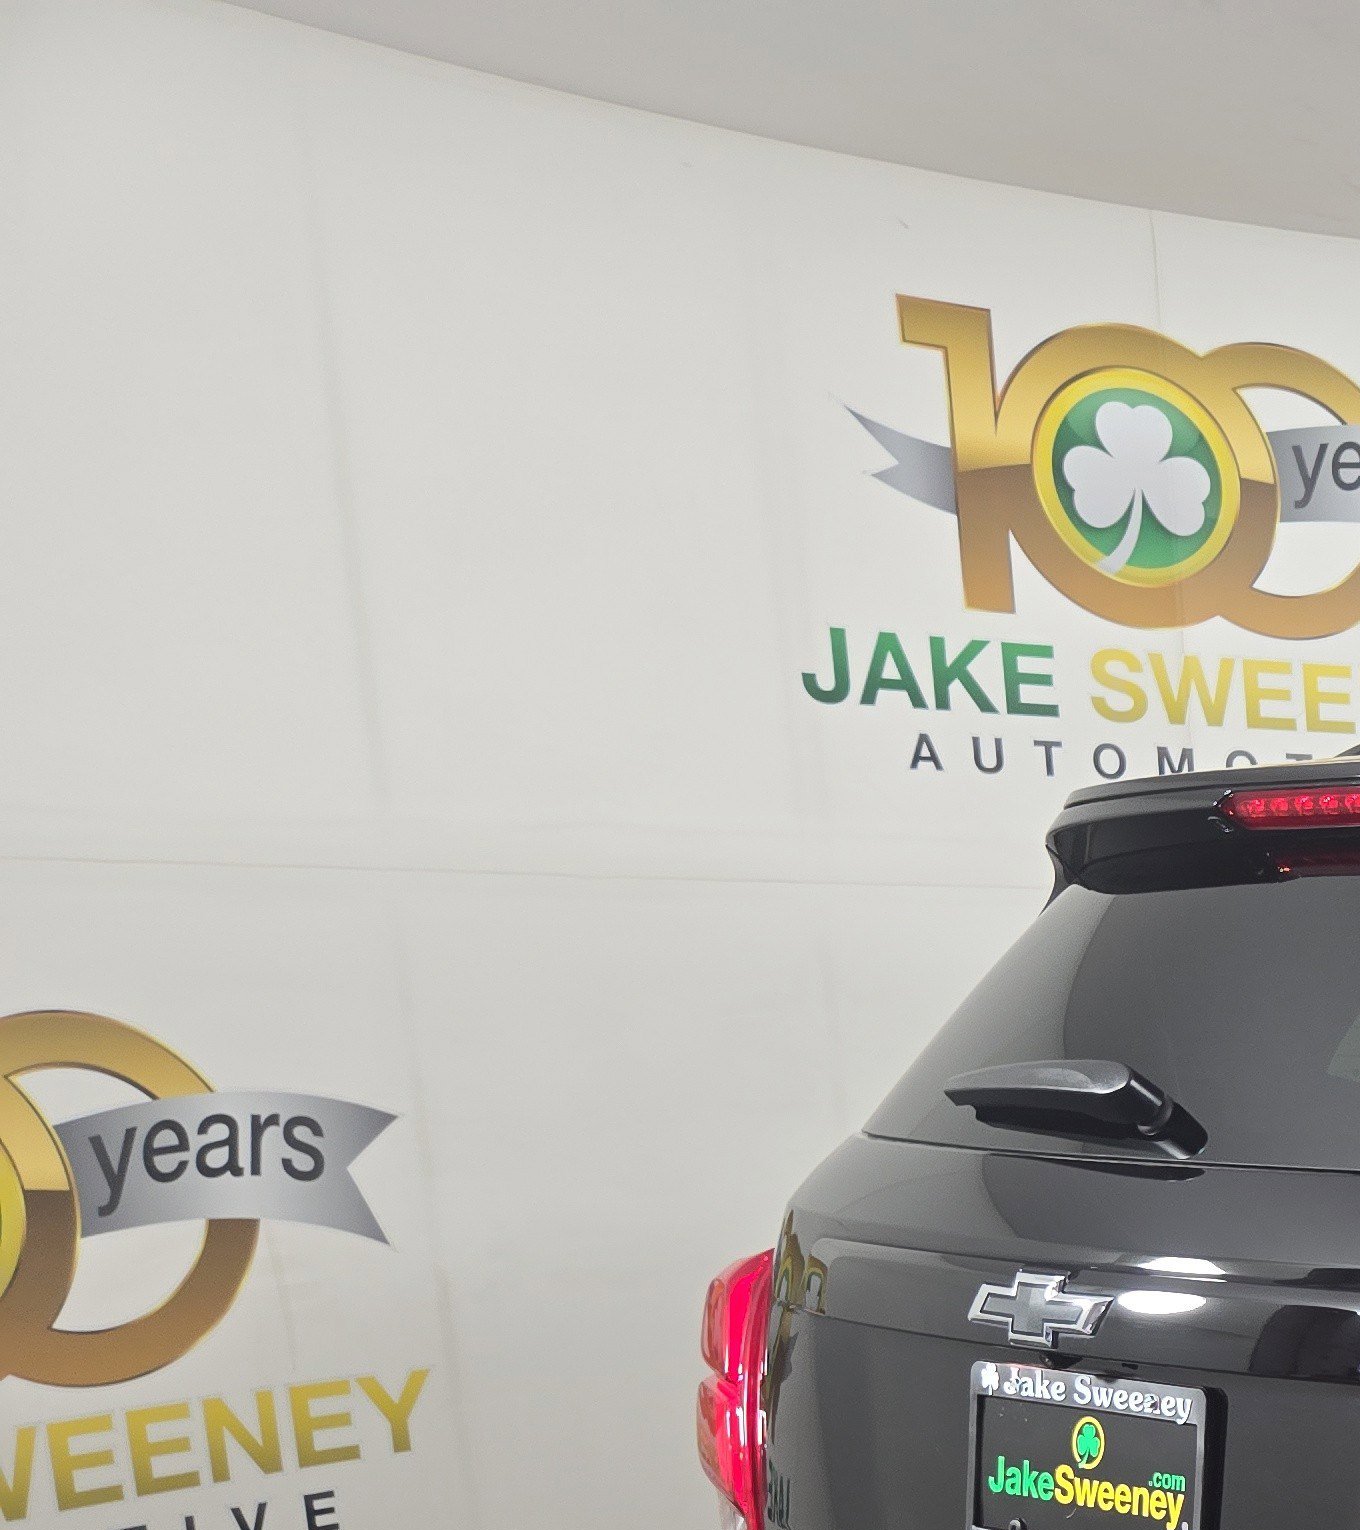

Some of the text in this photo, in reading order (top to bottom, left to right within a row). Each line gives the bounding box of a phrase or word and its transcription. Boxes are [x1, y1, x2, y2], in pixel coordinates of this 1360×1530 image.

[801, 626, 1060, 718] JAKE
[88, 1112, 326, 1217] years
[1003, 1366, 1193, 1425] Jake Sweeney
